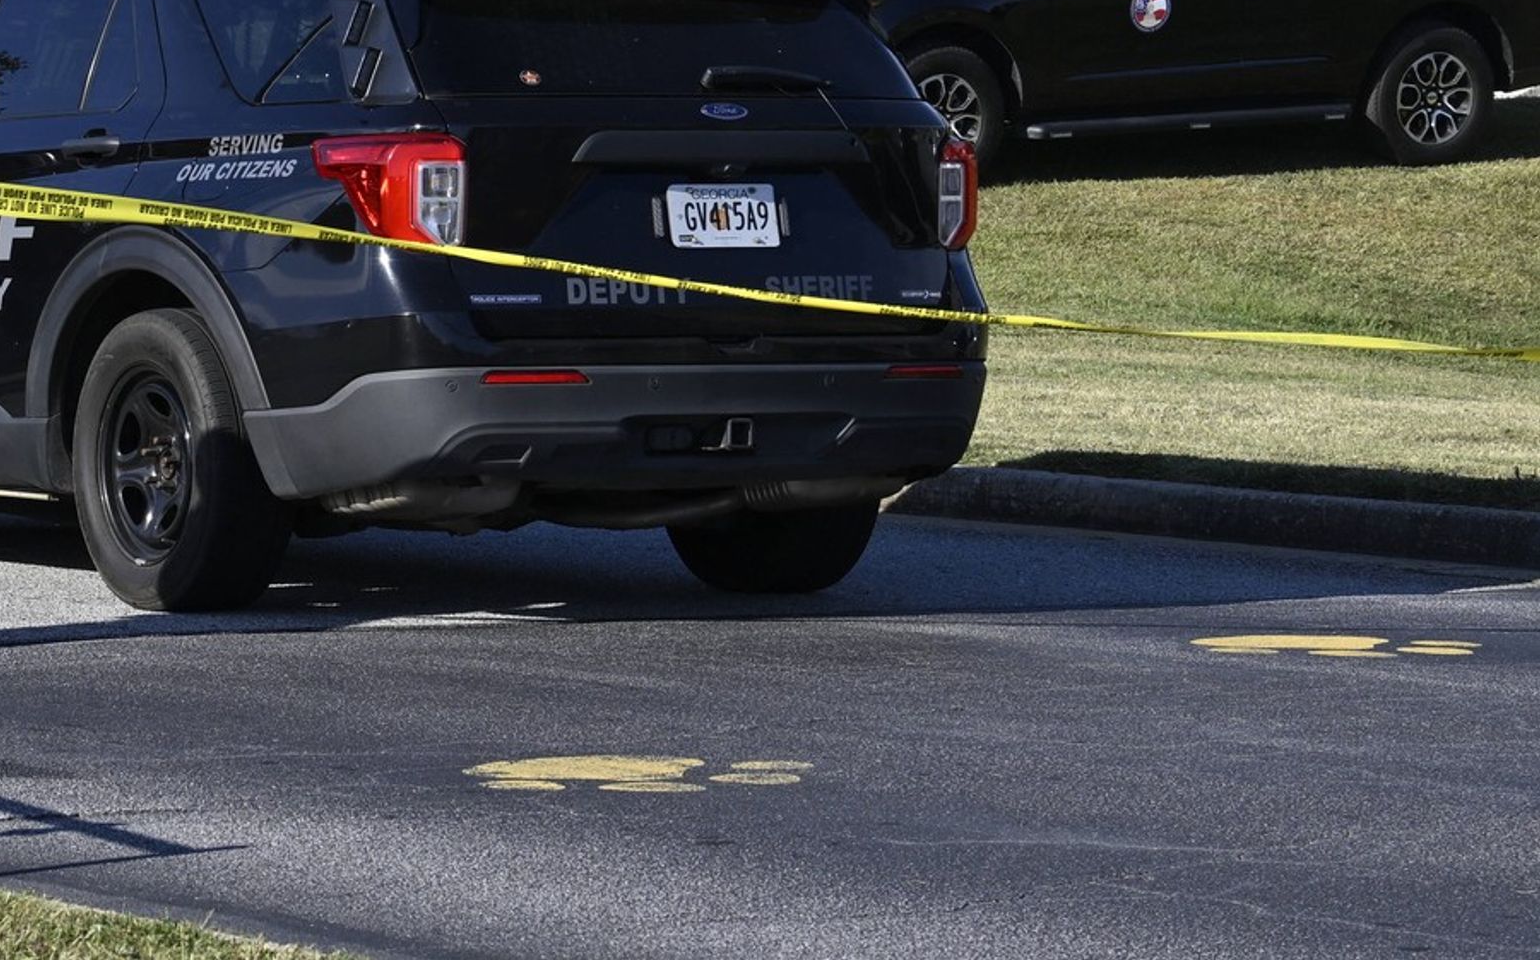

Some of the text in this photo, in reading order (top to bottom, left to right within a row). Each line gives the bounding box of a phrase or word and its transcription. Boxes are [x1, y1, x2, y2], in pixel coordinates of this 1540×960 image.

[208, 134, 284, 157] SERVING
[176, 159, 298, 183] OUR CITIZENS
[3, 189, 29, 201] FAVOR
[30, 191, 46, 202] POR
[48, 193, 77, 206] POLICIA
[691, 188, 749, 199] GEORGIA
[10, 200, 25, 212] NOT
[78, 196, 89, 207] DE
[91, 198, 113, 210] LINEA
[27, 202, 38, 214] DO
[40, 204, 57, 216] LINE
[58, 206, 85, 219] POLICE
[139, 204, 170, 217] CRUZAR
[172, 208, 182, 218] NO
[184, 209, 209, 222] FAVOR
[210, 212, 226, 224] POR
[685, 202, 769, 231] GV415A9
[228, 215, 257, 230] POLICIA
[258, 220, 269, 231] DE
[271, 223, 292, 234] LINEA
[765, 274, 874, 301] SHERIFF
